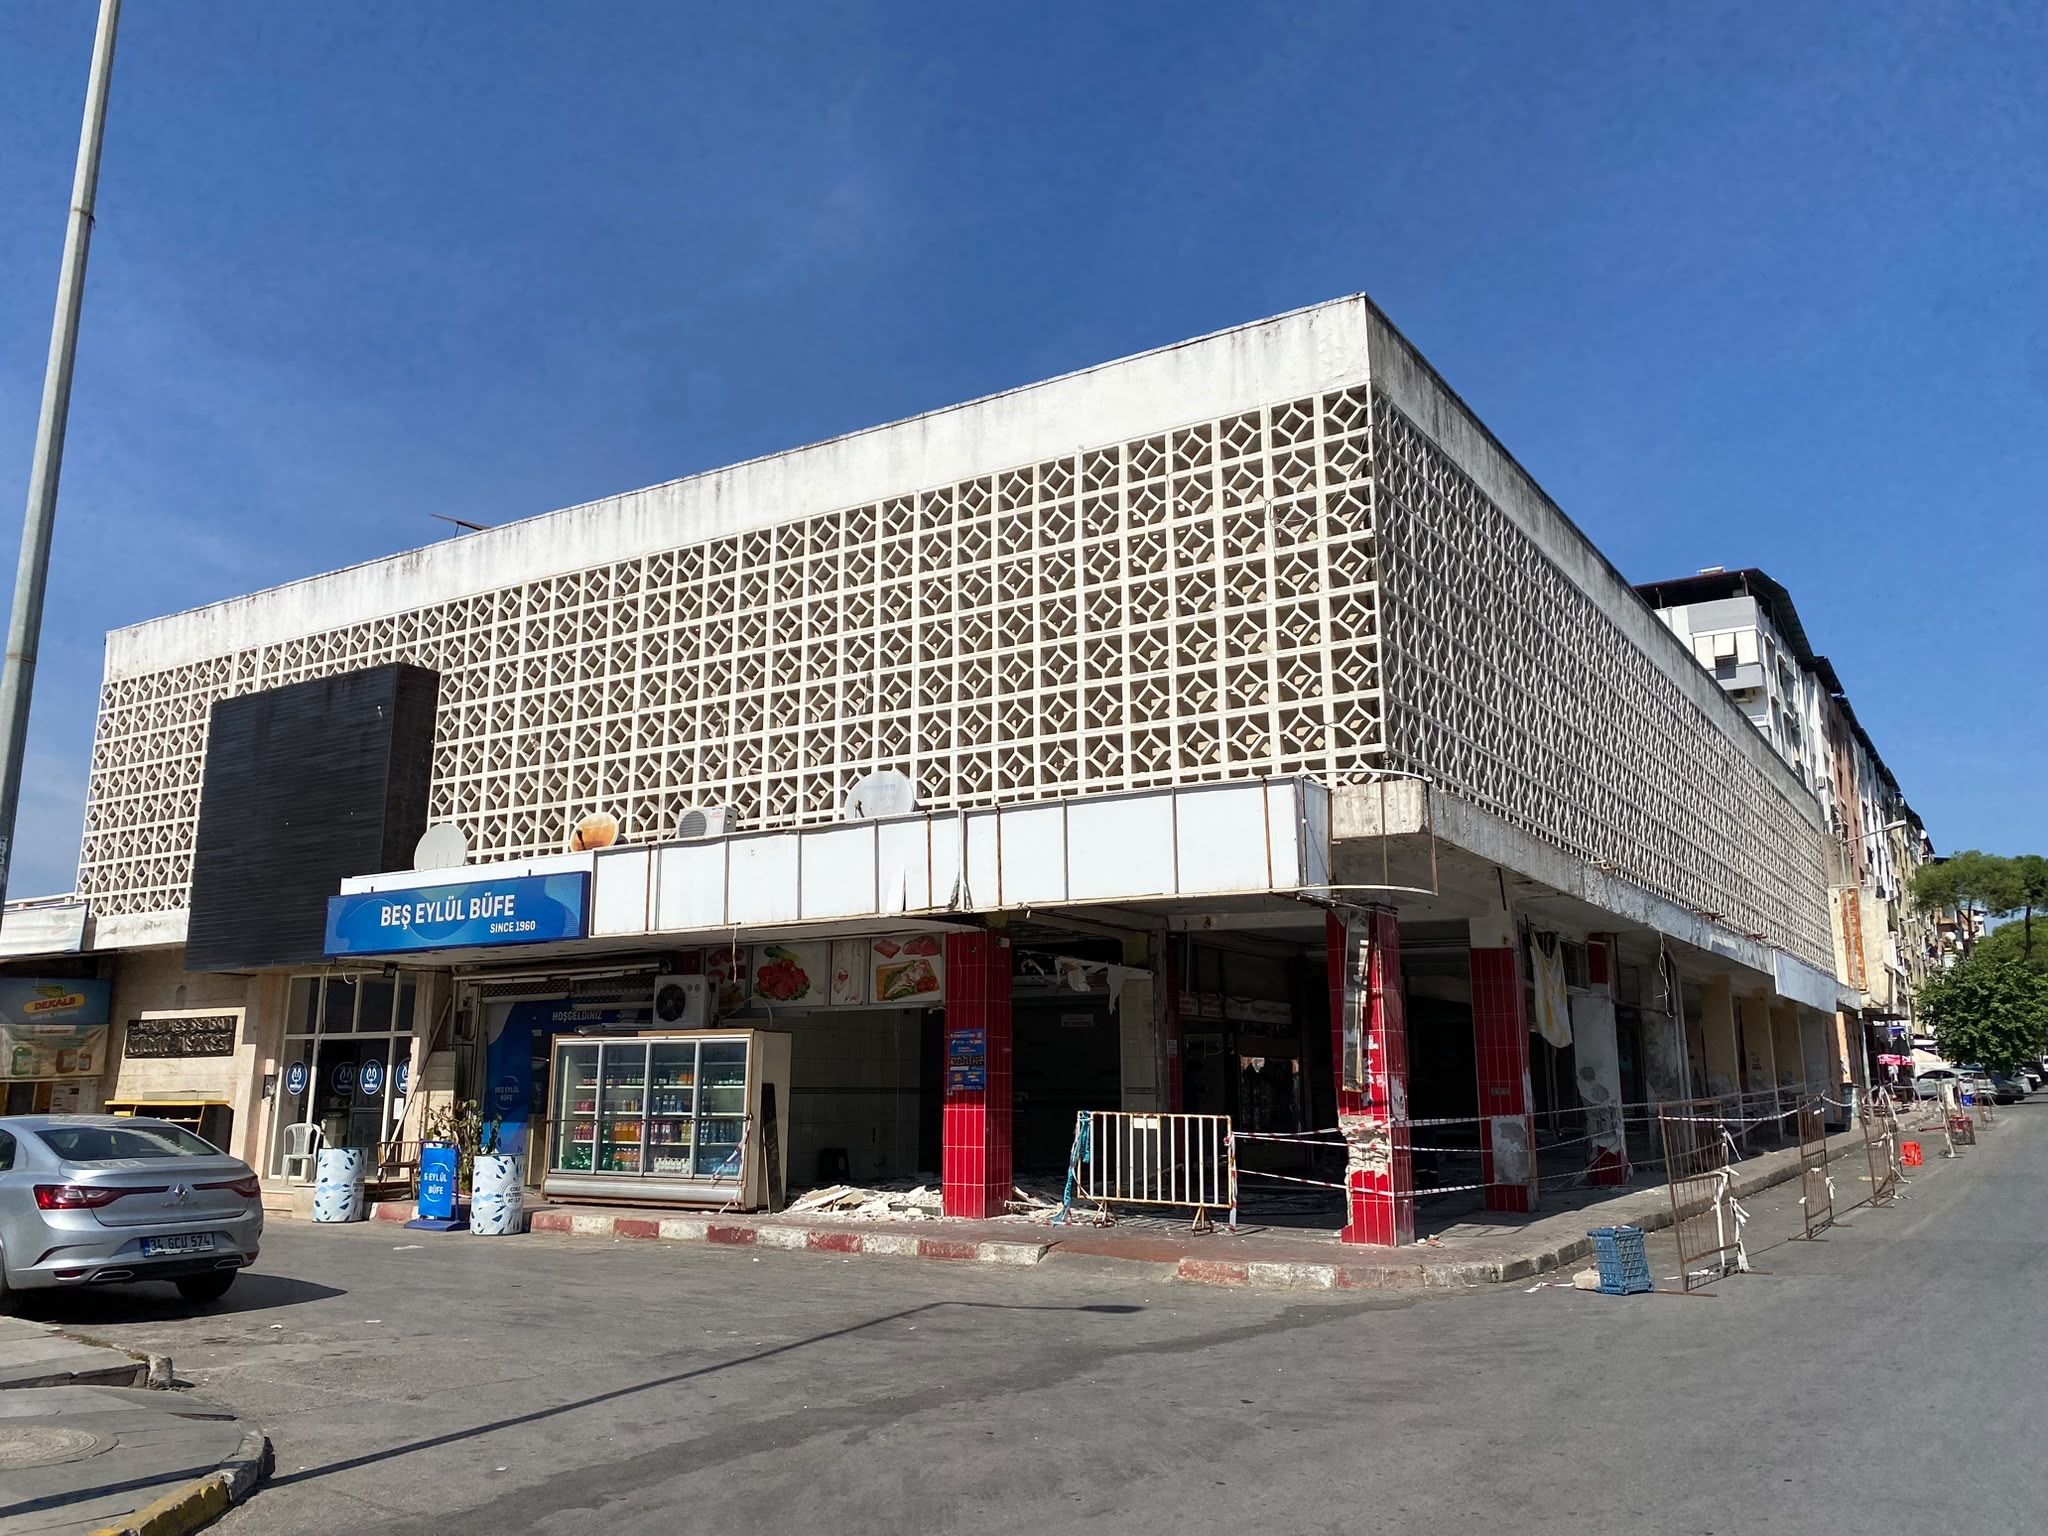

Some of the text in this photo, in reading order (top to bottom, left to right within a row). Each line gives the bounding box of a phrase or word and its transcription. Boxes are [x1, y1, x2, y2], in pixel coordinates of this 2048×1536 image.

[381, 892, 515, 930] BEŞ EYLÜL BÜFE
[489, 920, 536, 934] SINCE 1960
